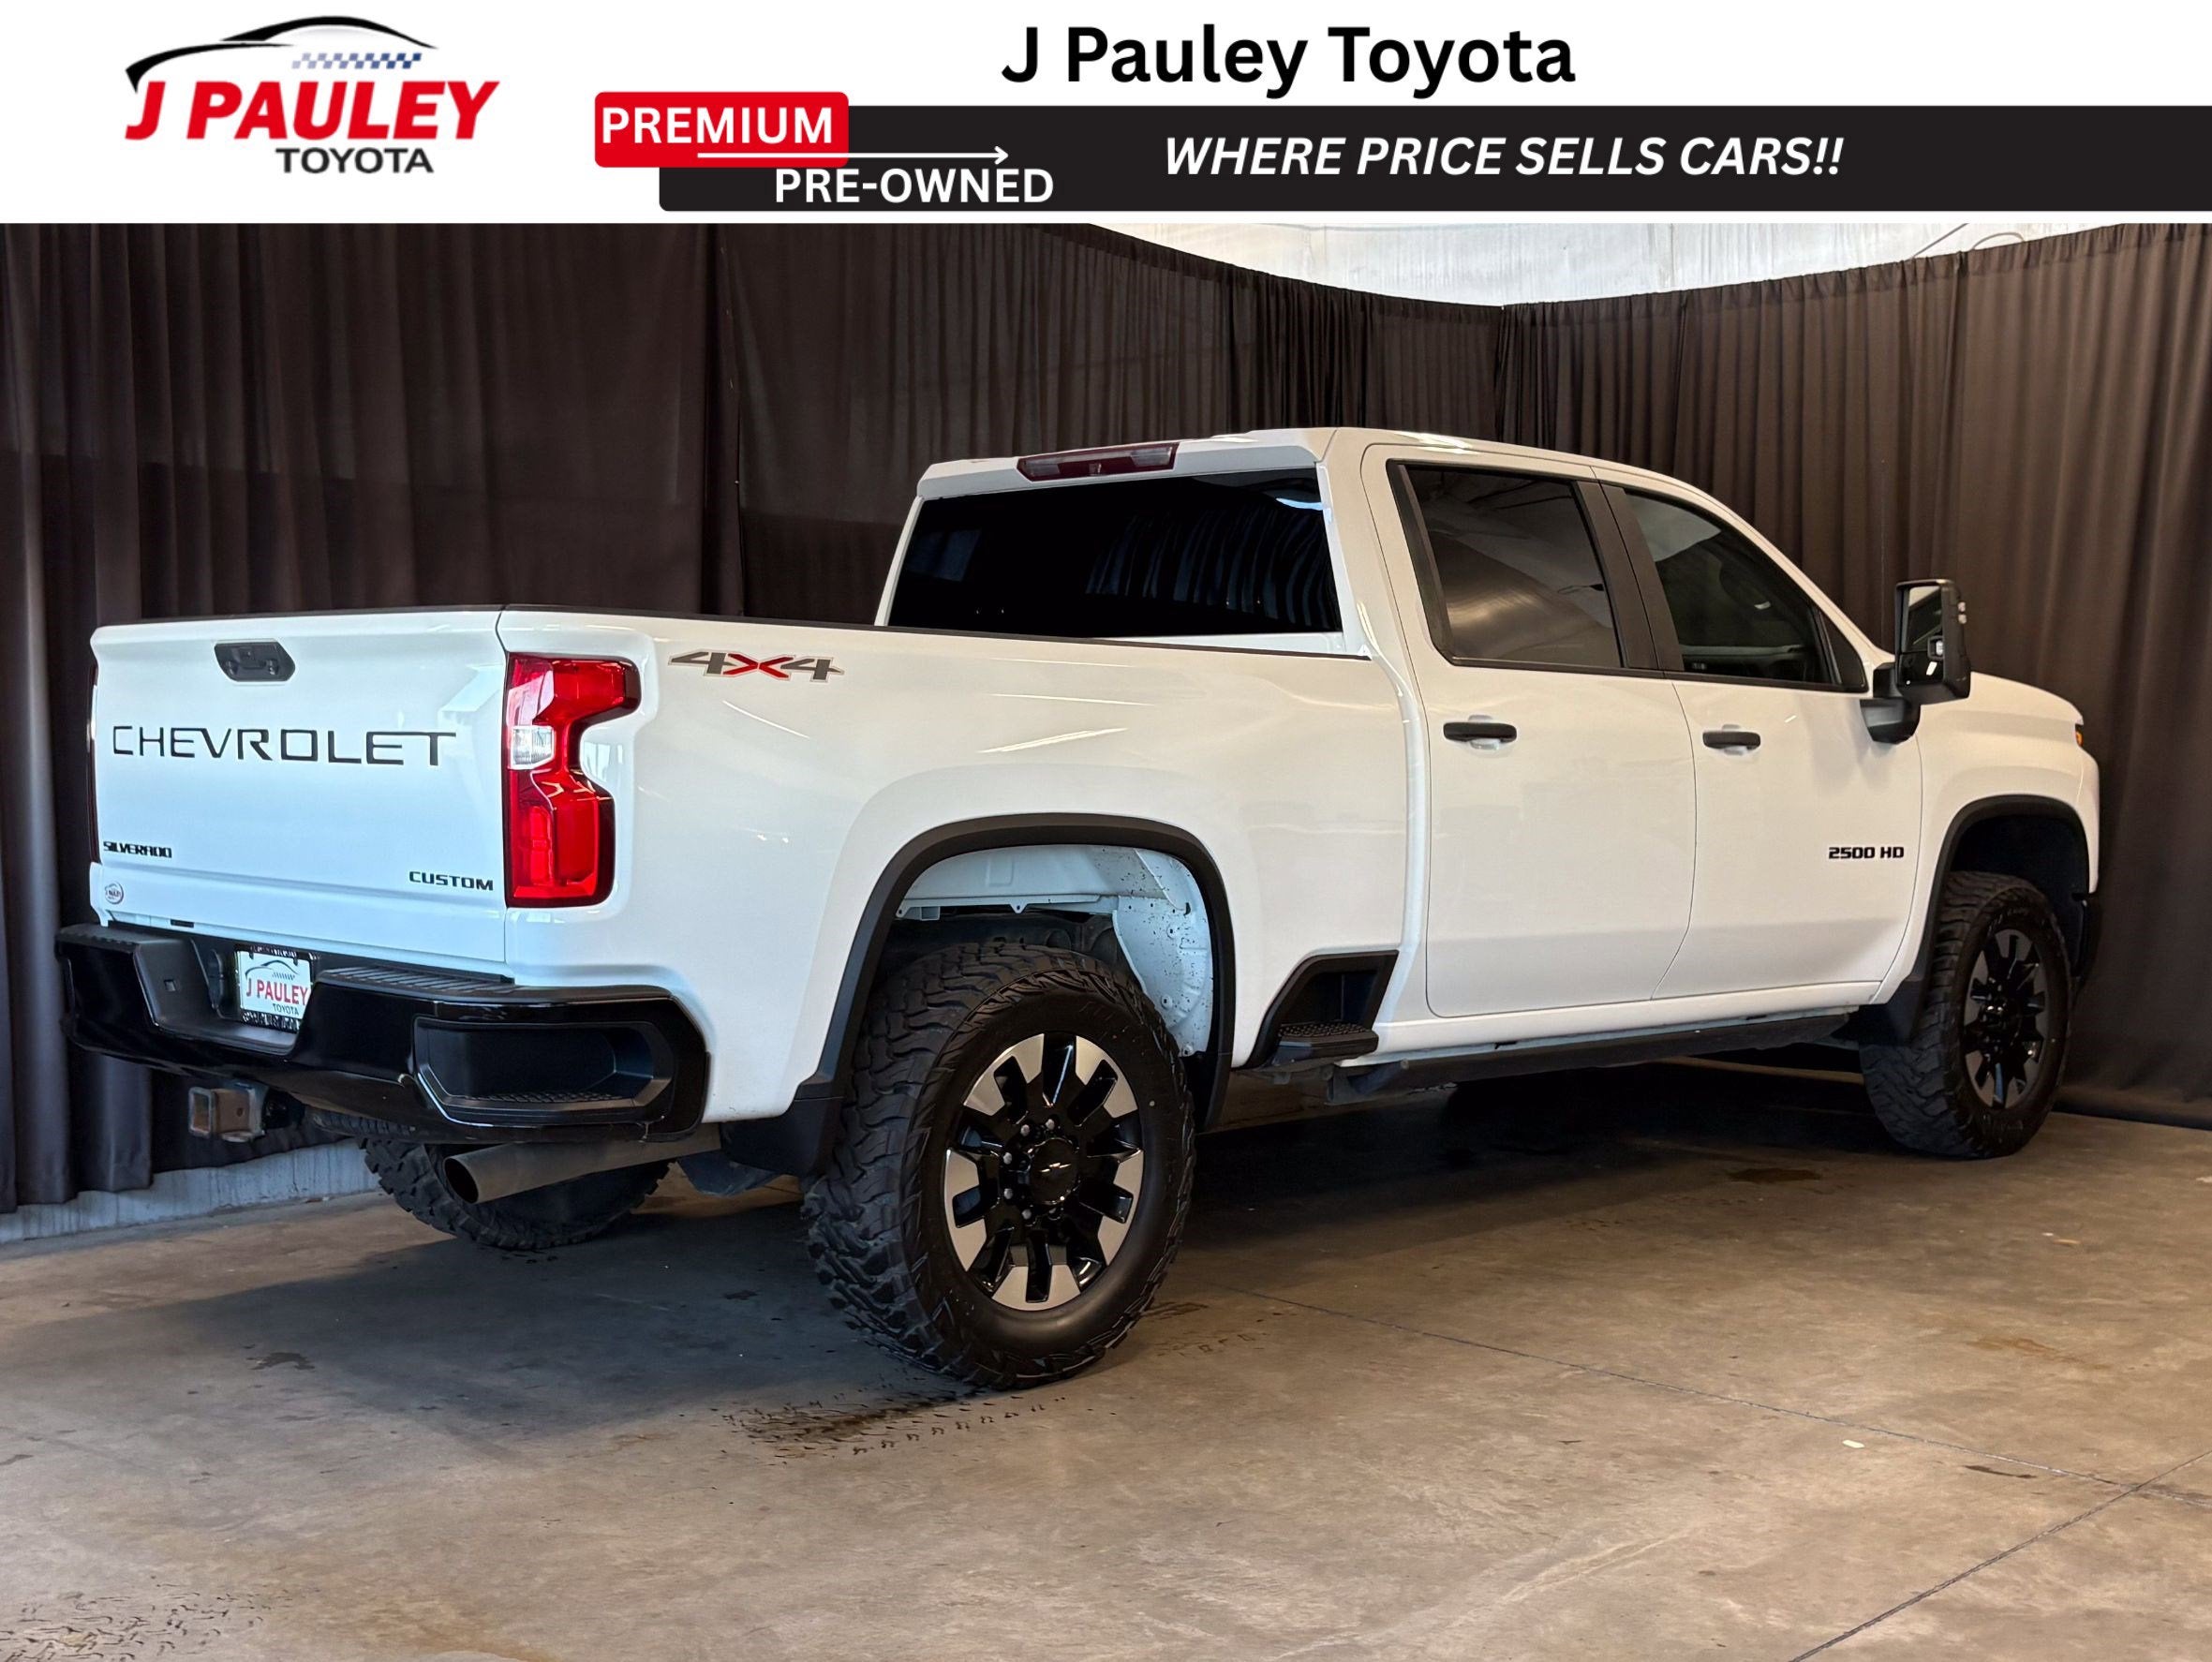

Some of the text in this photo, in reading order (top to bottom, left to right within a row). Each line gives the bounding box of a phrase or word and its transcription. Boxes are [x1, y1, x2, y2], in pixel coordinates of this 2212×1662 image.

[113, 726, 455, 765] CHEVROLET
[103, 840, 172, 858] SILVERADO
[1828, 846, 1905, 859] 2500 HD
[408, 870, 494, 891] CUSTOM
[246, 977, 308, 1006] J PAULEY
[273, 1003, 299, 1016] TOYOTA
